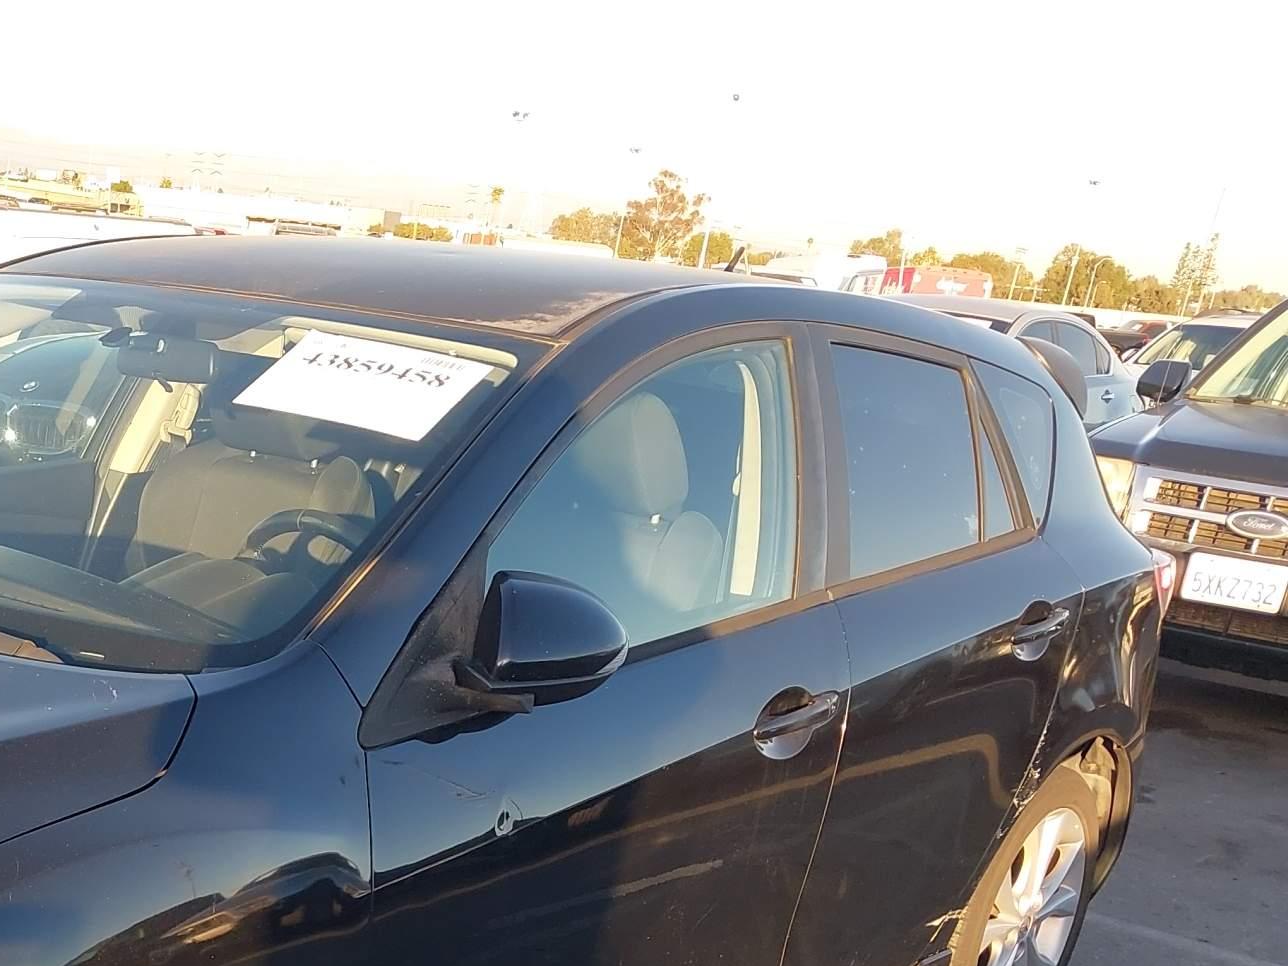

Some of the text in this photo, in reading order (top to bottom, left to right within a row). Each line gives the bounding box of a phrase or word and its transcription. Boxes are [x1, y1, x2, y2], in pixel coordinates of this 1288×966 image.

[302, 352, 450, 387] 43859458
[1243, 517, 1275, 529] Ford
[1191, 571, 1277, 605] 5XKZ732
